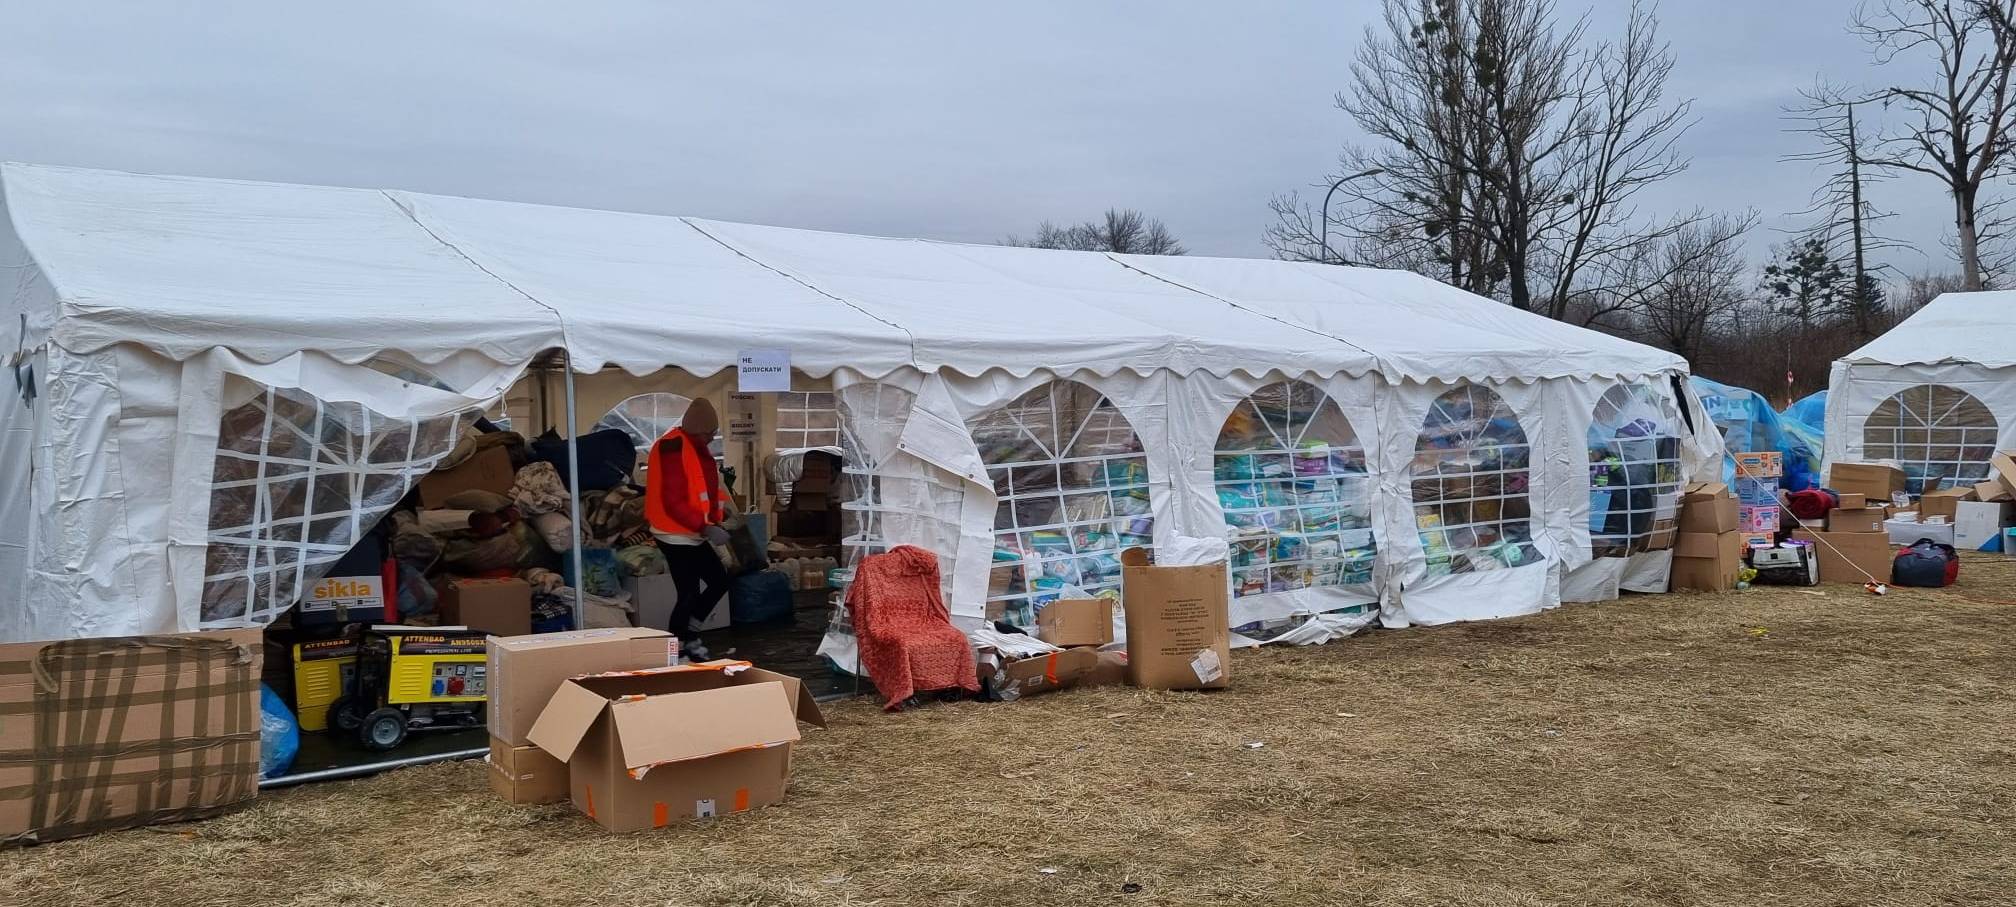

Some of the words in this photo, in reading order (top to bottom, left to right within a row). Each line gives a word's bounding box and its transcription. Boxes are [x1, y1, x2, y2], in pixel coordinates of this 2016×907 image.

[314, 579, 370, 599] sikla
[305, 638, 350, 649] ATTENBAD
[404, 635, 445, 643] ATTENBAD
